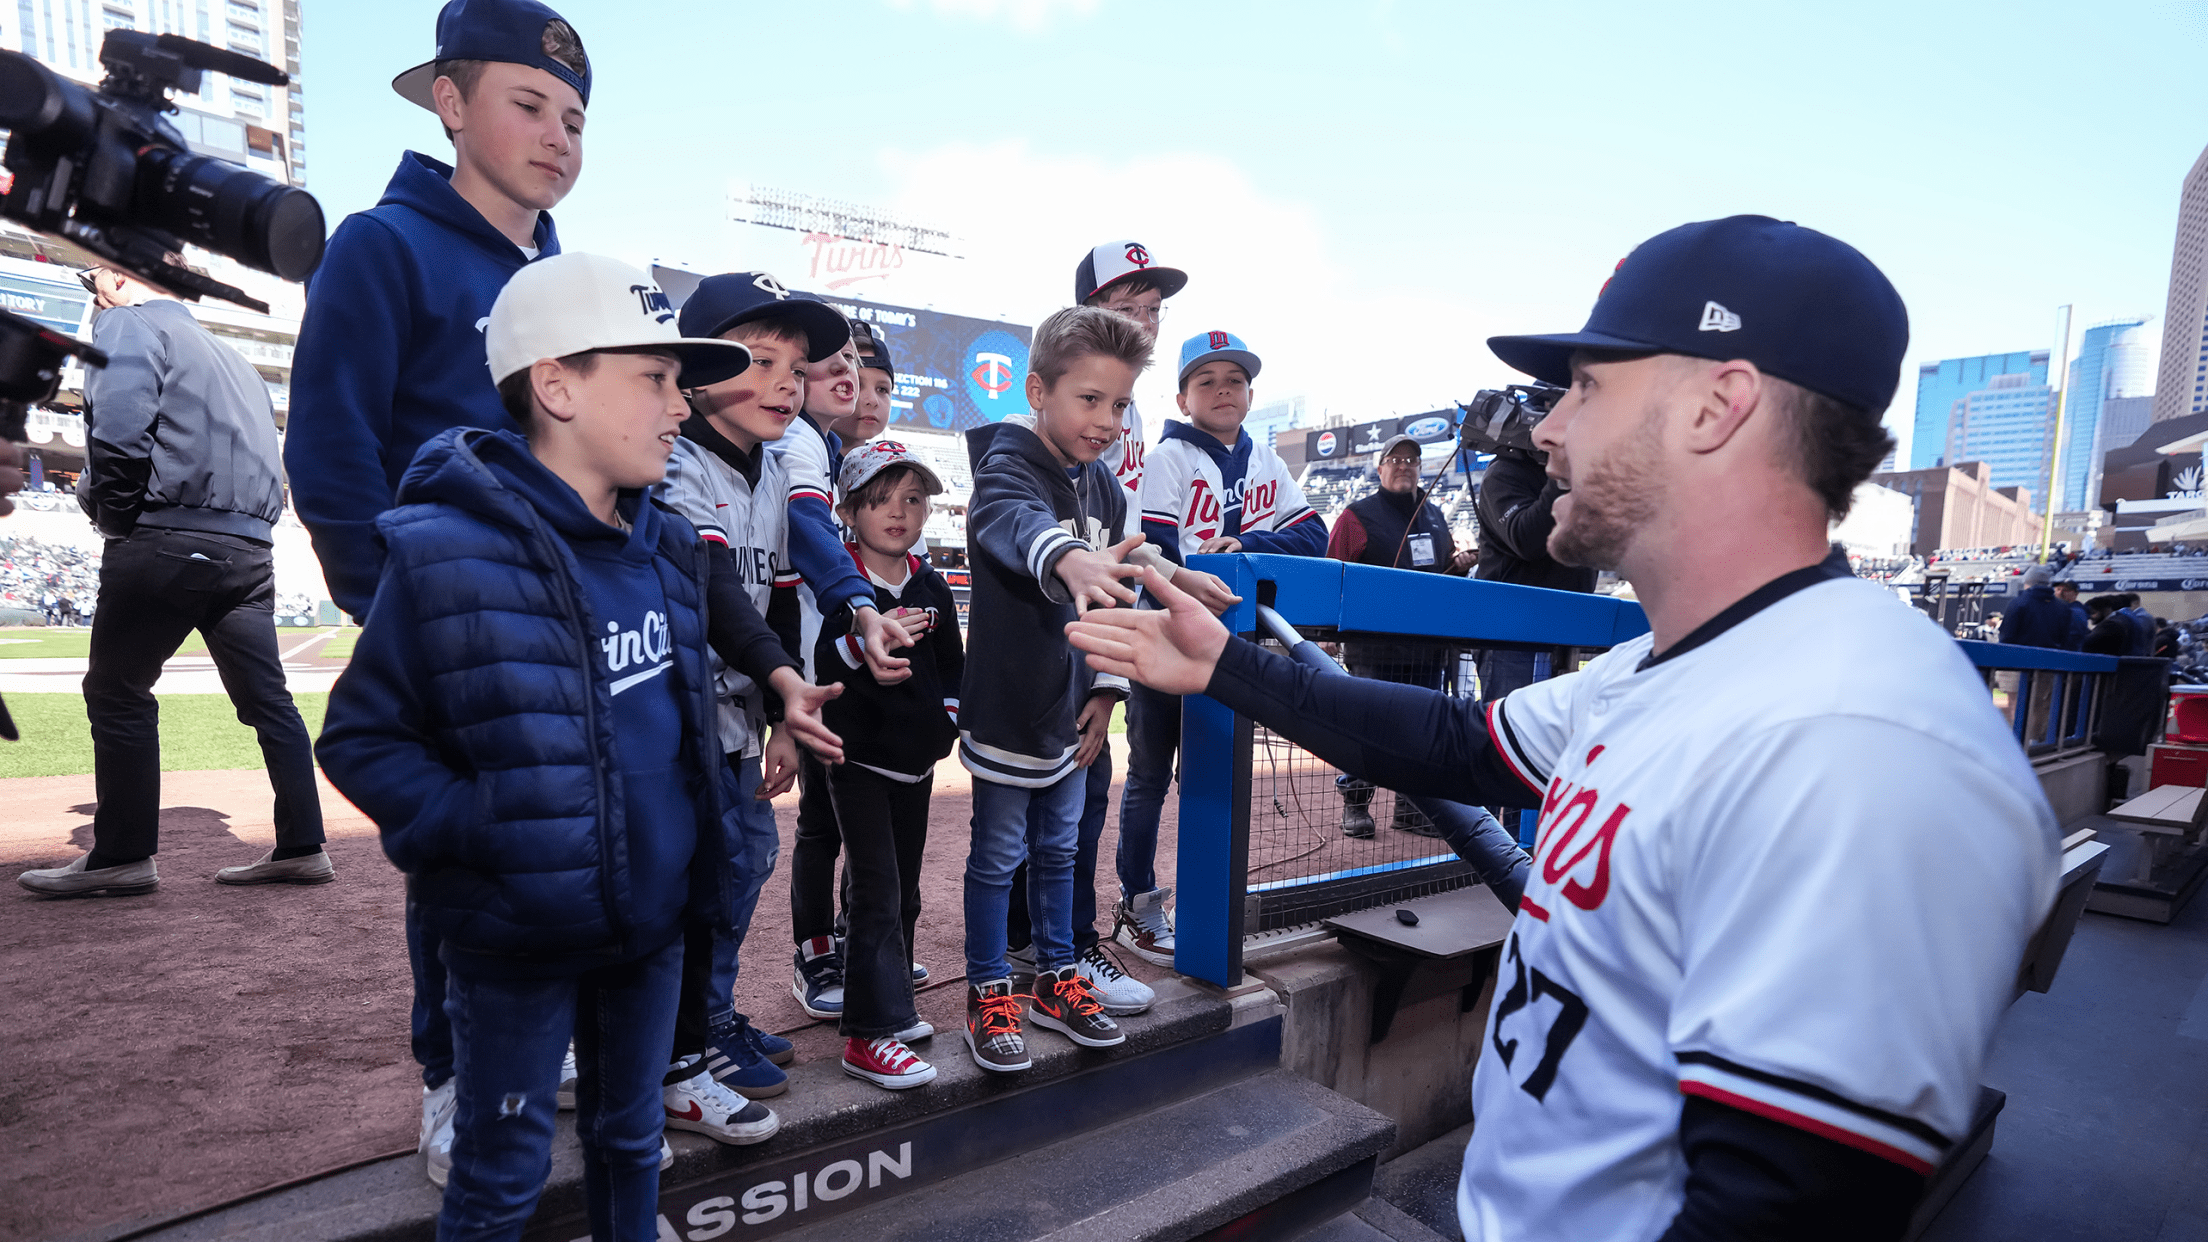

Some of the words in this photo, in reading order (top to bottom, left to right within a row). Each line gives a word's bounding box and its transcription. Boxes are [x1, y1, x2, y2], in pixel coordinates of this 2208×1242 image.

[800, 231, 904, 280] Twins
[859, 307, 874, 321] OF
[874, 309, 917, 328] TODAY'S
[900, 385, 921, 397] 222
[1493, 931, 1589, 1105] 27
